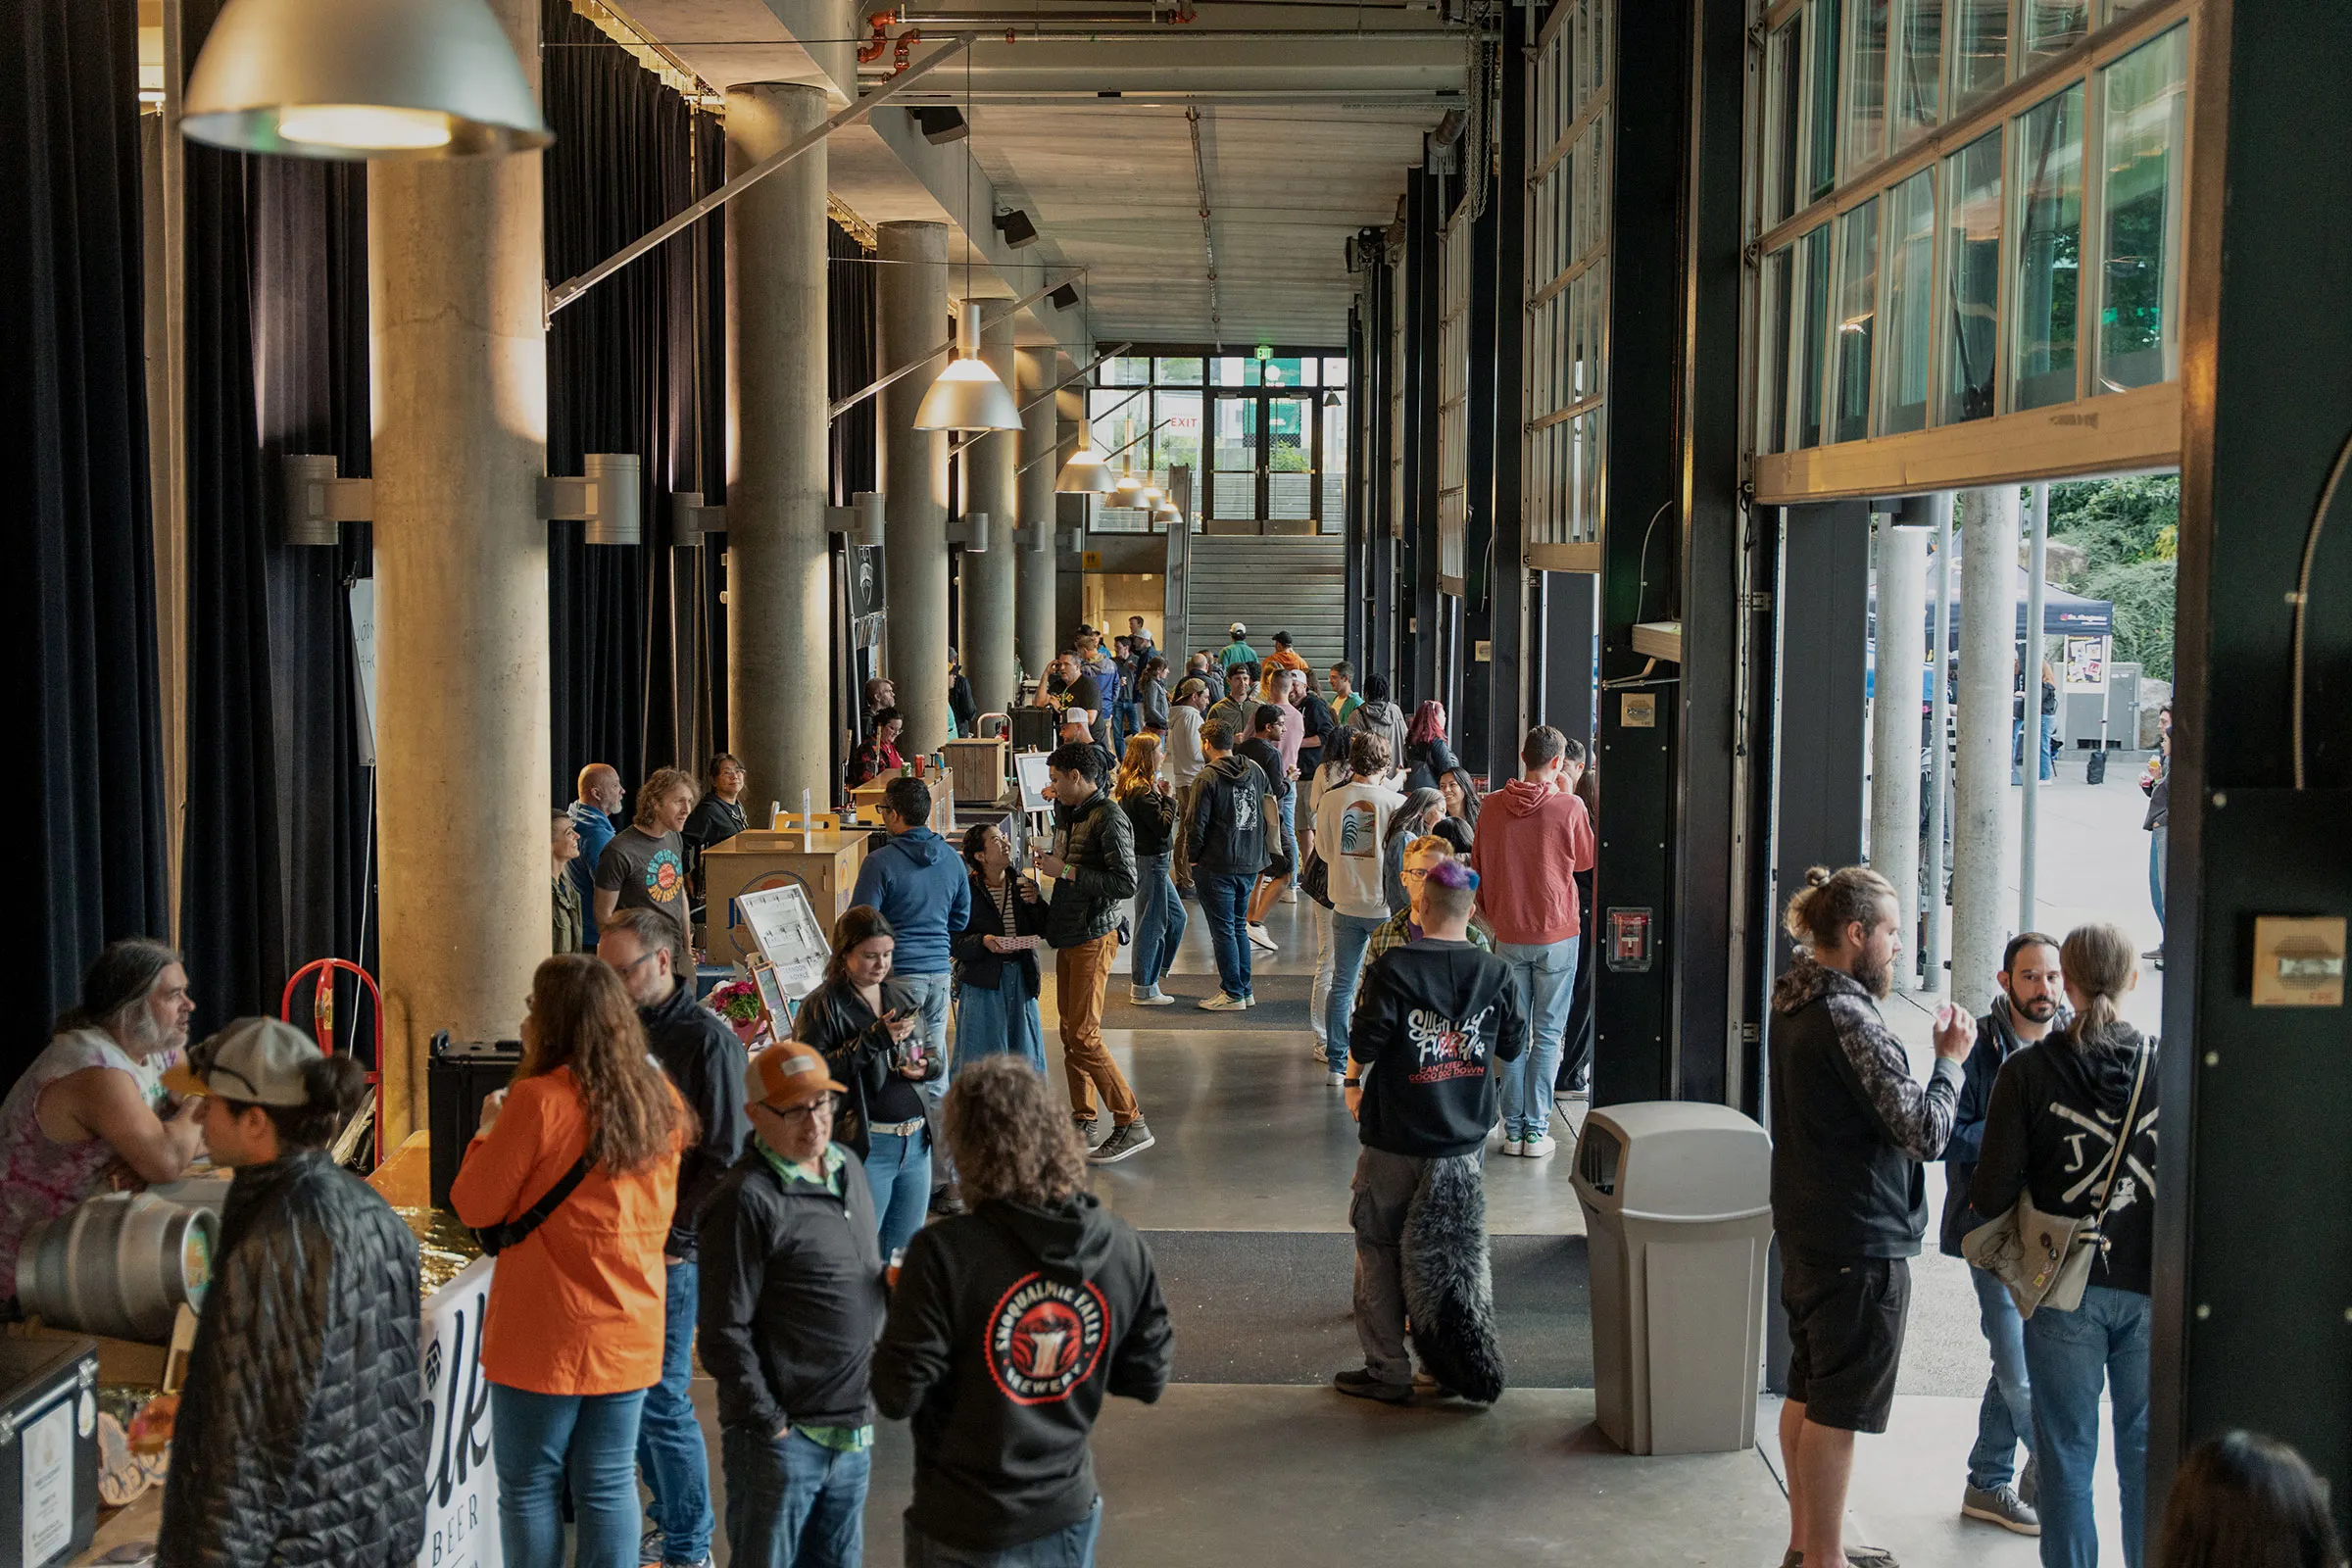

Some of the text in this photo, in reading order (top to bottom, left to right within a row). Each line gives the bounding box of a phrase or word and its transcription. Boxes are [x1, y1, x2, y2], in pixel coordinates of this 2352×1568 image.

[1257, 349, 1271, 359] EXIT
[1171, 417, 1198, 427] EXIT
[1408, 1072, 1438, 1081] GOOD
[1453, 1066, 1485, 1075] DOWN
[995, 1280, 1102, 1351] SNOQUALMIE FALLS
[1006, 1363, 1082, 1394] BREWERY
[432, 1493, 479, 1568] BEER
